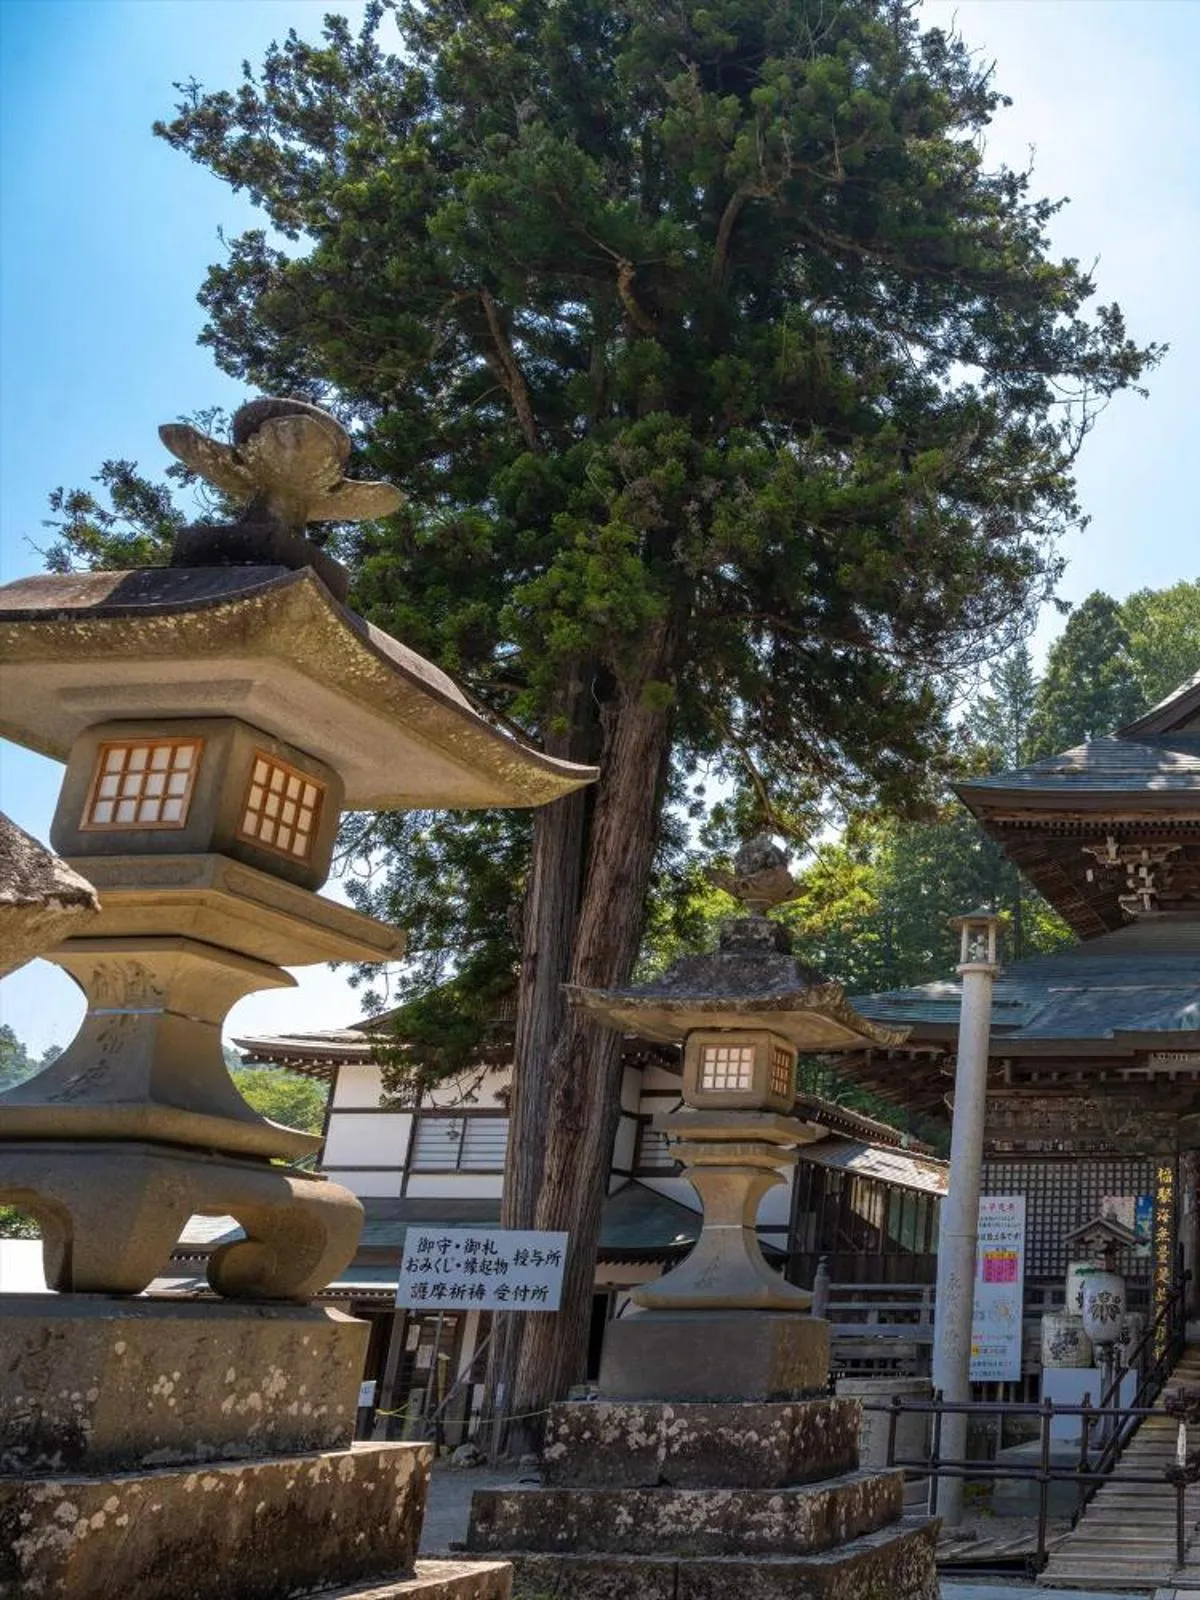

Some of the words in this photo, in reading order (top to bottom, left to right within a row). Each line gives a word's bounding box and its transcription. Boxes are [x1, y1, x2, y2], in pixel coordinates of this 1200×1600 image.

[513, 1248, 562, 1268] 授与所
[493, 1283, 550, 1302] 受付所
